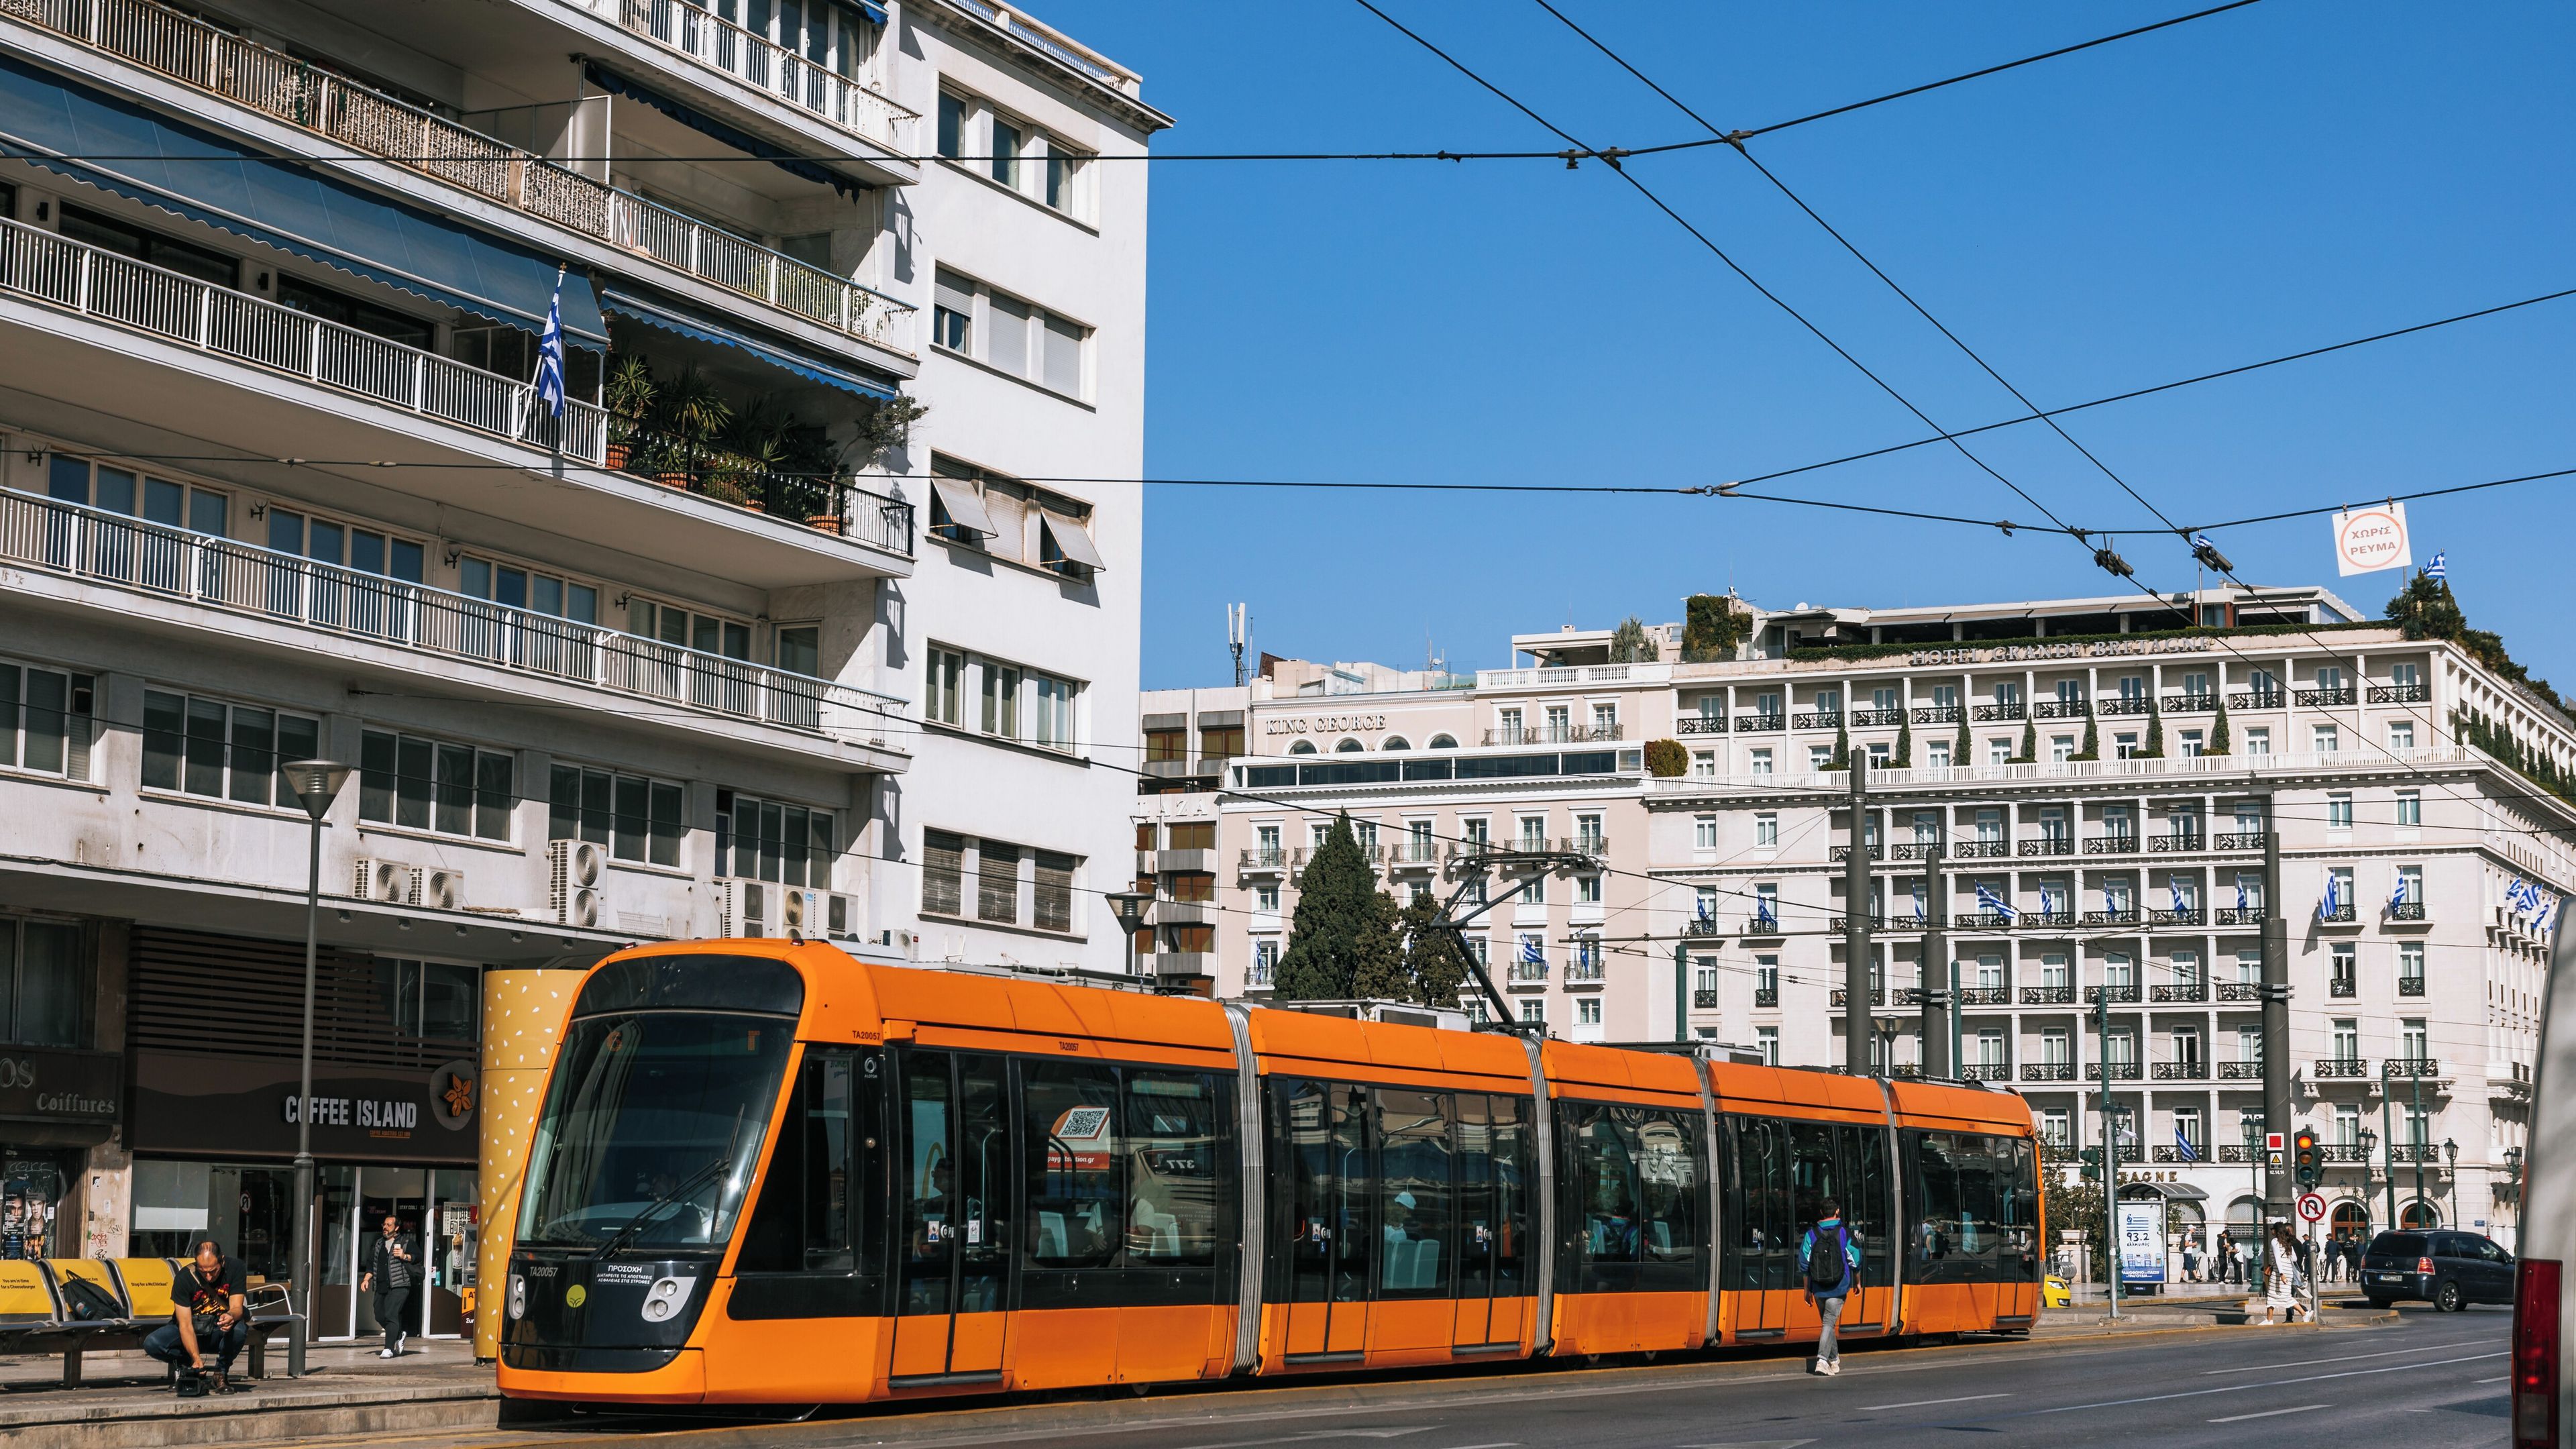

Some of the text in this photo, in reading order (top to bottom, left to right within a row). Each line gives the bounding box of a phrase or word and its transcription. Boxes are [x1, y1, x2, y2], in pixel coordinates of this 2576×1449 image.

[2351, 526, 2392, 539] ΧΩΡΙΣ
[2351, 541, 2396, 555] ΡΕΥΜΑ
[1911, 636, 2211, 665] HOTEL GRANDE BRETAGNE
[1267, 714, 1386, 735] KING GEORGE
[852, 1030, 880, 1041] TA20057
[37, 1092, 115, 1113] Coiffures
[356, 1099, 417, 1128] ISLAND
[2127, 1232, 2150, 1242] 93.2
[530, 1267, 558, 1277] TA20057
[608, 1265, 643, 1273] ΠΡΟΣΟΧΗ
